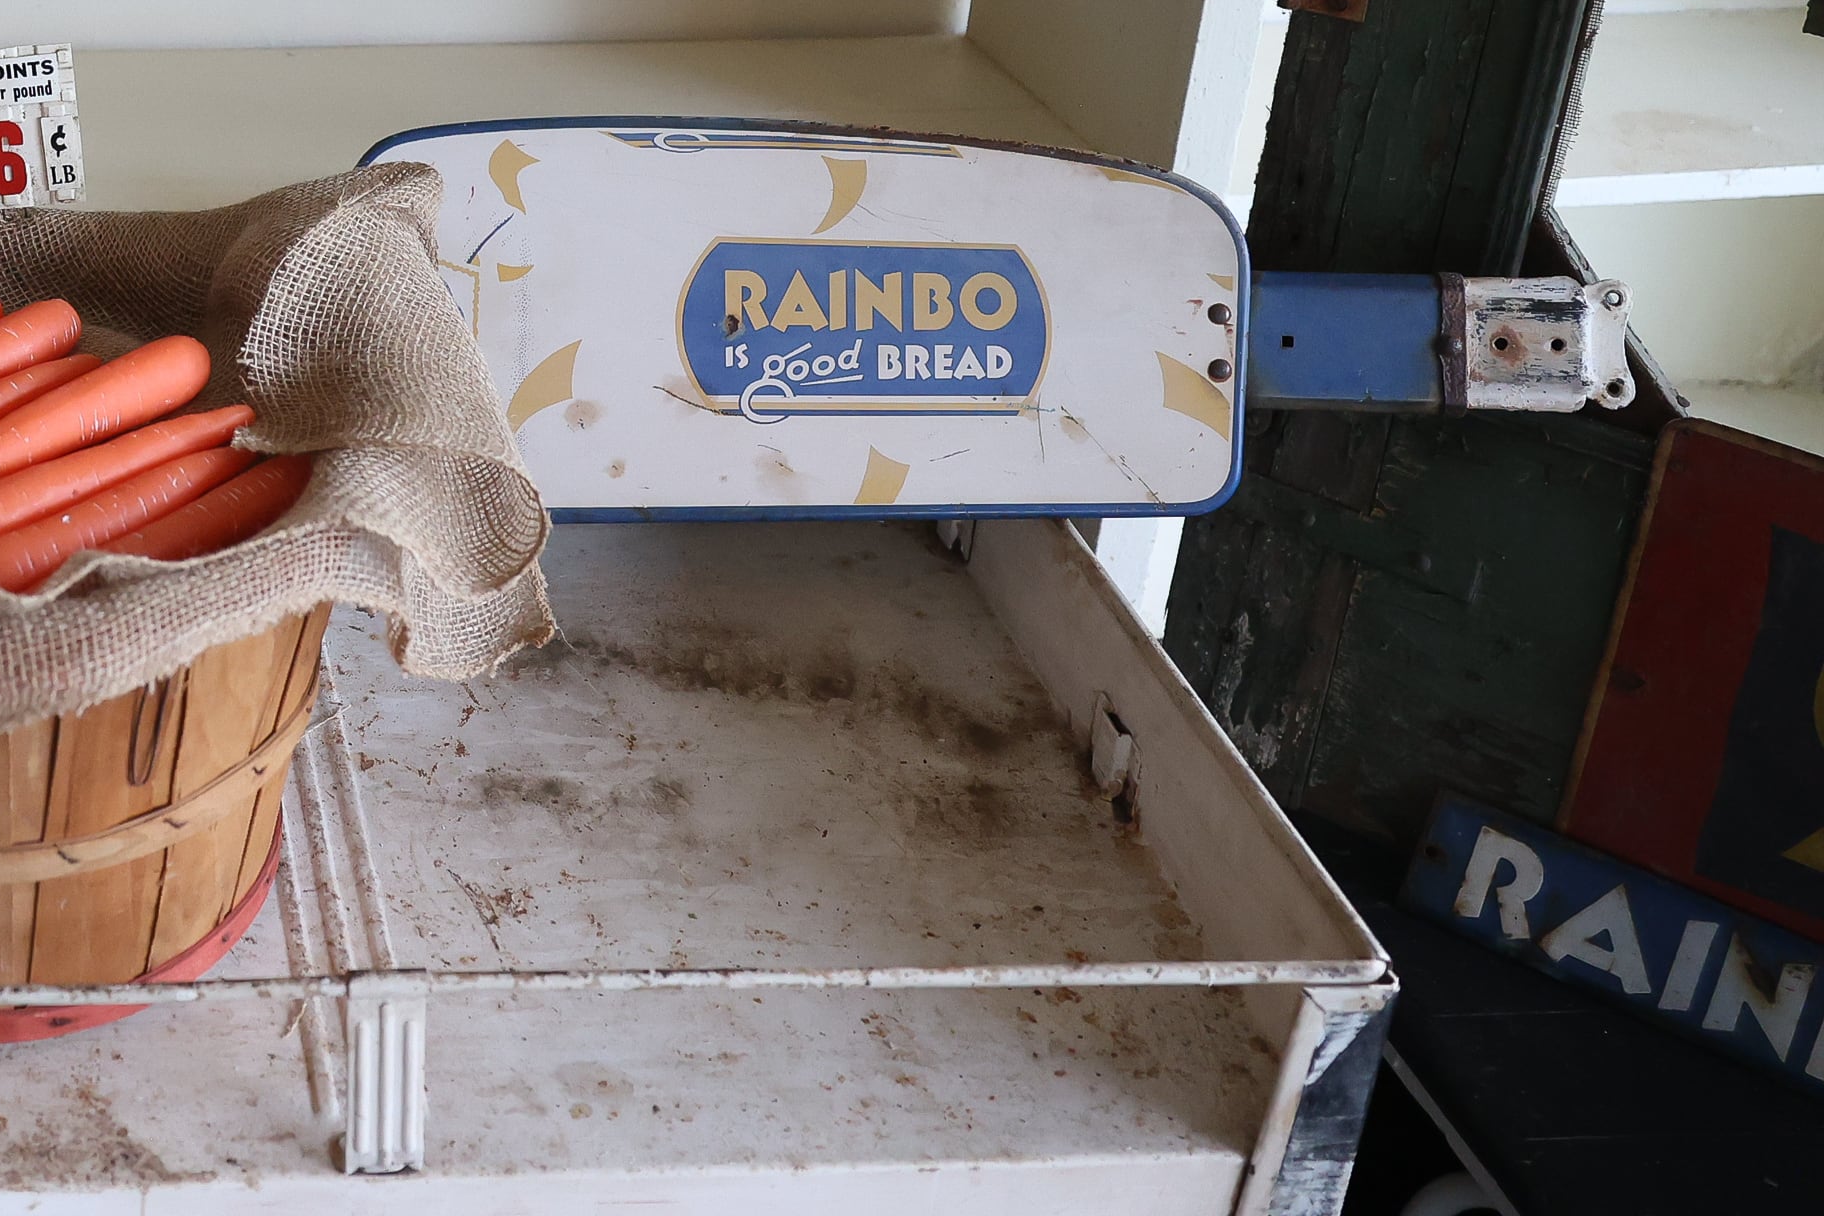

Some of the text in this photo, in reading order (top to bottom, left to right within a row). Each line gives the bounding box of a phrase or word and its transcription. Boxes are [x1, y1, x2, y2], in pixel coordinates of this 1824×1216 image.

[13, 79, 53, 103] pound
[50, 124, 68, 158] ¢
[49, 164, 77, 186] LB
[723, 268, 1019, 335] RAINBO
[725, 338, 1014, 384] IS good BREAD
